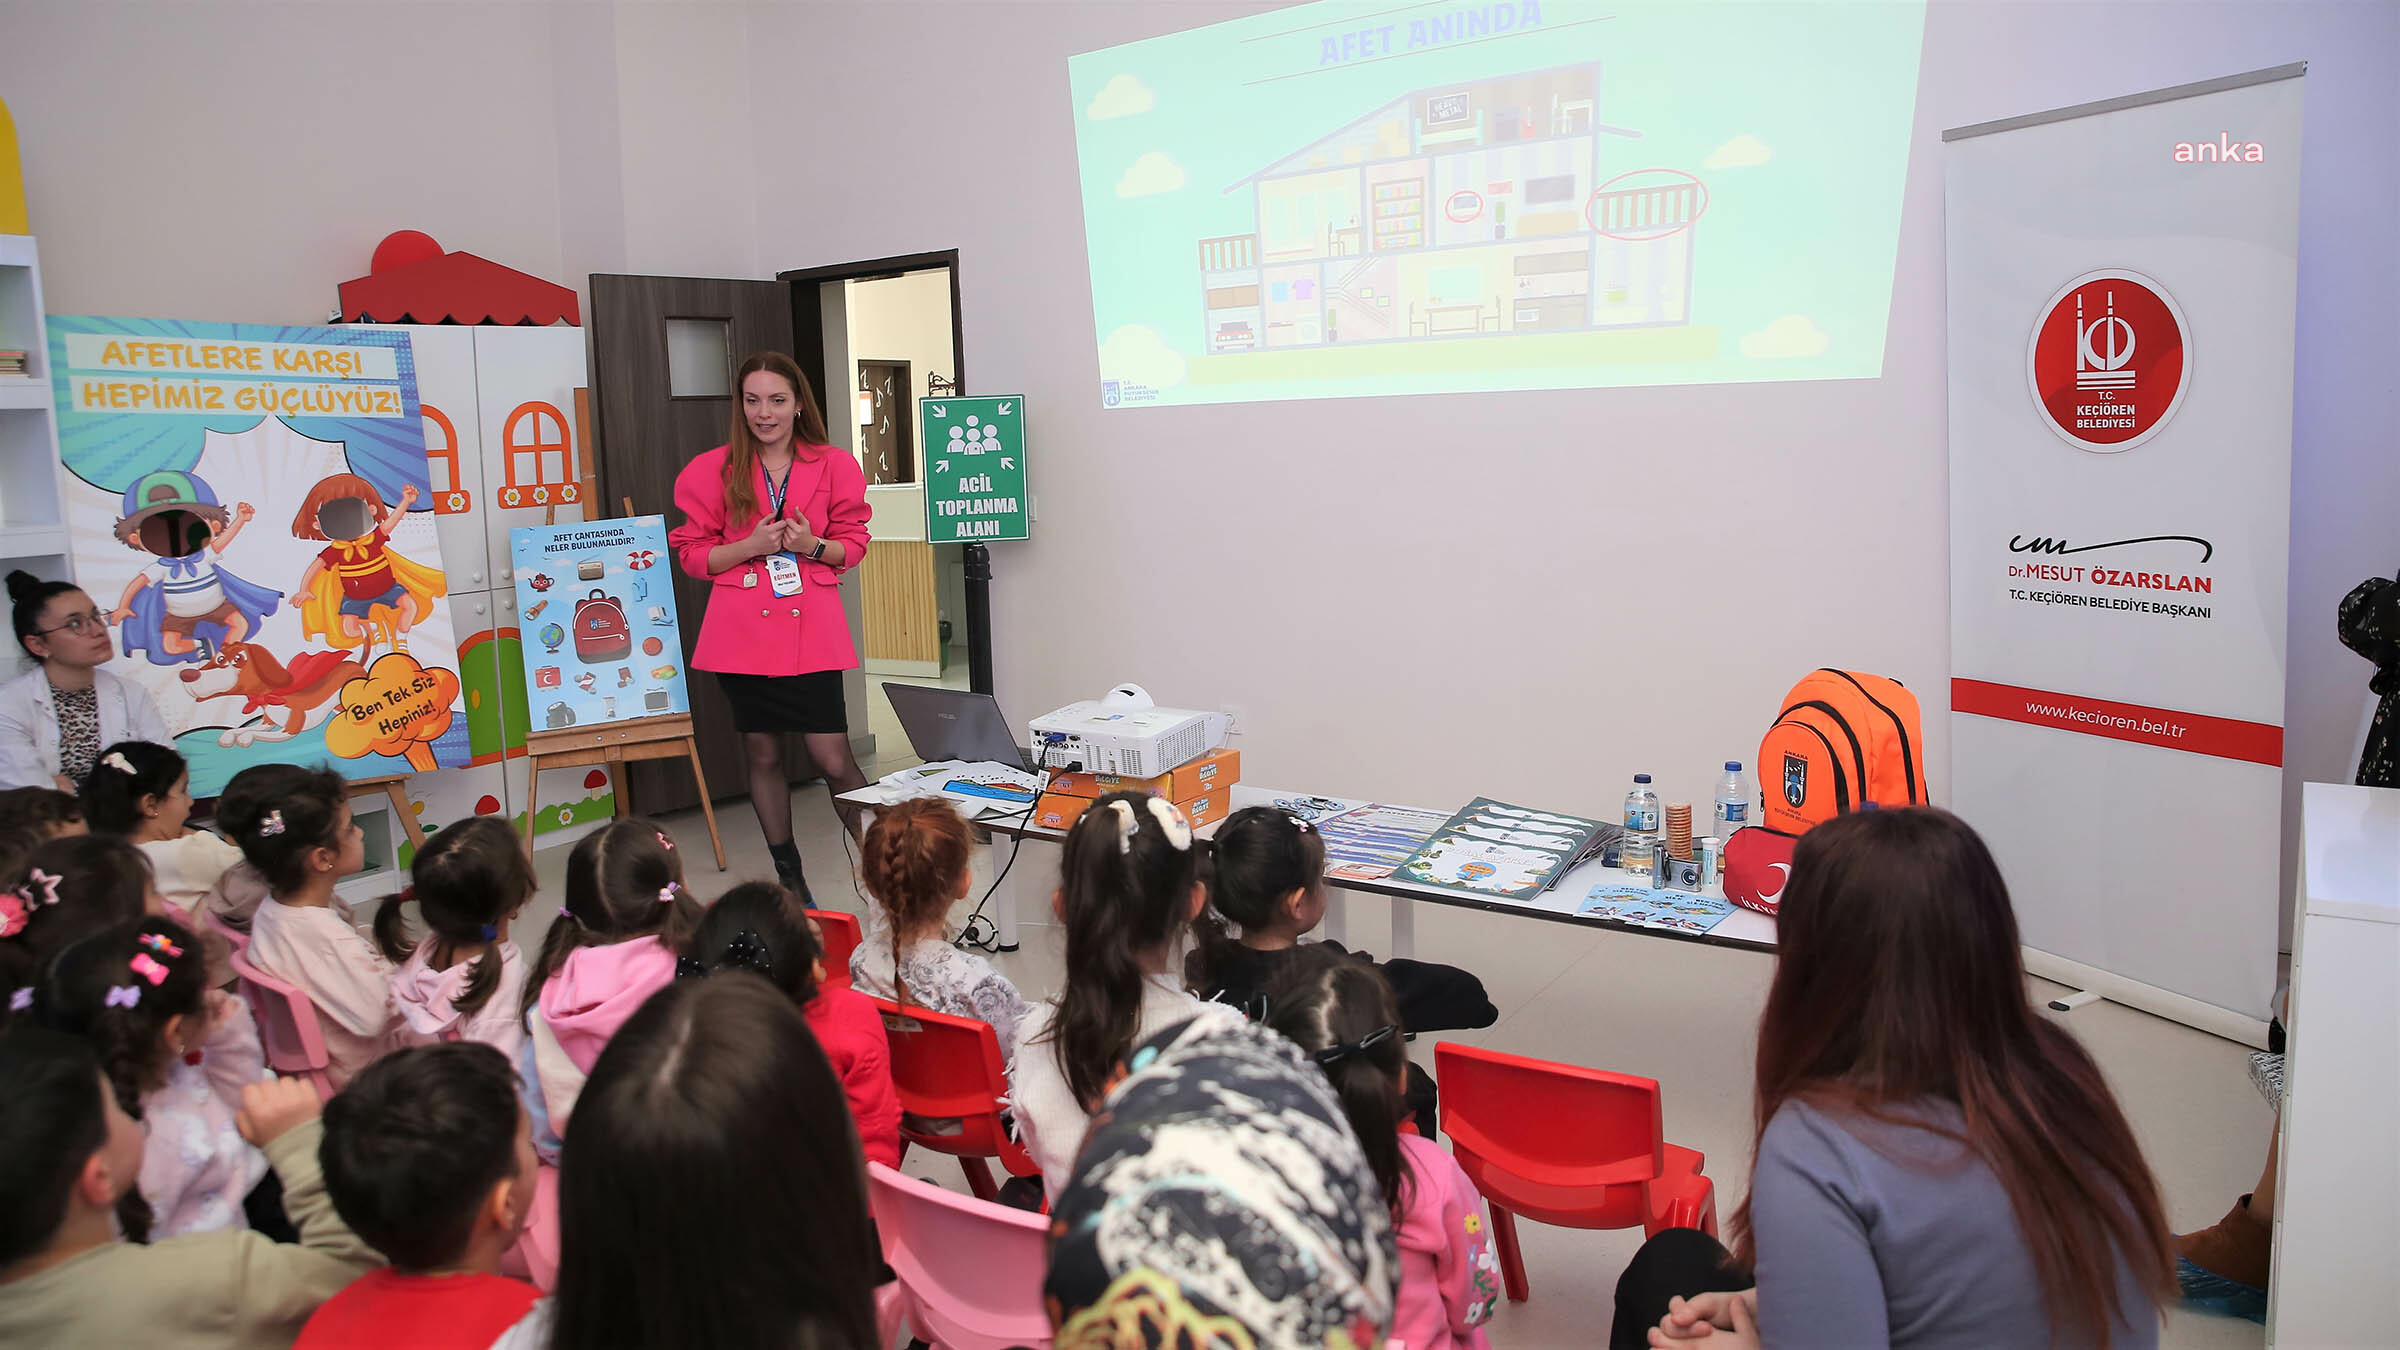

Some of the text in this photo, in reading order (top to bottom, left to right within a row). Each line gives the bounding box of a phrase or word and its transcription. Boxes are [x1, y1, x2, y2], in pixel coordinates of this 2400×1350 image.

[1319, 0, 1544, 65] AFET ANINDA
[101, 341, 362, 379] AFETLERE KARŞI
[83, 377, 402, 418] HEPİMİZ GÜÇLÜYÜZ!
[2098, 392, 2116, 400] T.C.
[2076, 402, 2135, 418] KEÇİÖREN
[2076, 416, 2135, 428] BELEDİYESİ
[959, 473, 993, 493] ACİL
[936, 497, 1018, 516] TOPLANMA
[553, 528, 624, 542] AFET ÇANTASINDA
[956, 520, 1000, 537] ALANI
[545, 537, 635, 552] NELER BULUNMALIDIR?
[2091, 566, 2212, 593] ÖZARSLAN
[2009, 589, 2211, 618] T.C. KEÇİÖREN BELEDİYE BAŞKANI
[351, 677, 436, 720] Ben Tek Siz
[378, 699, 436, 735] Hepiniz!
[2025, 702, 2187, 738] www.kecioren.bel.tr
